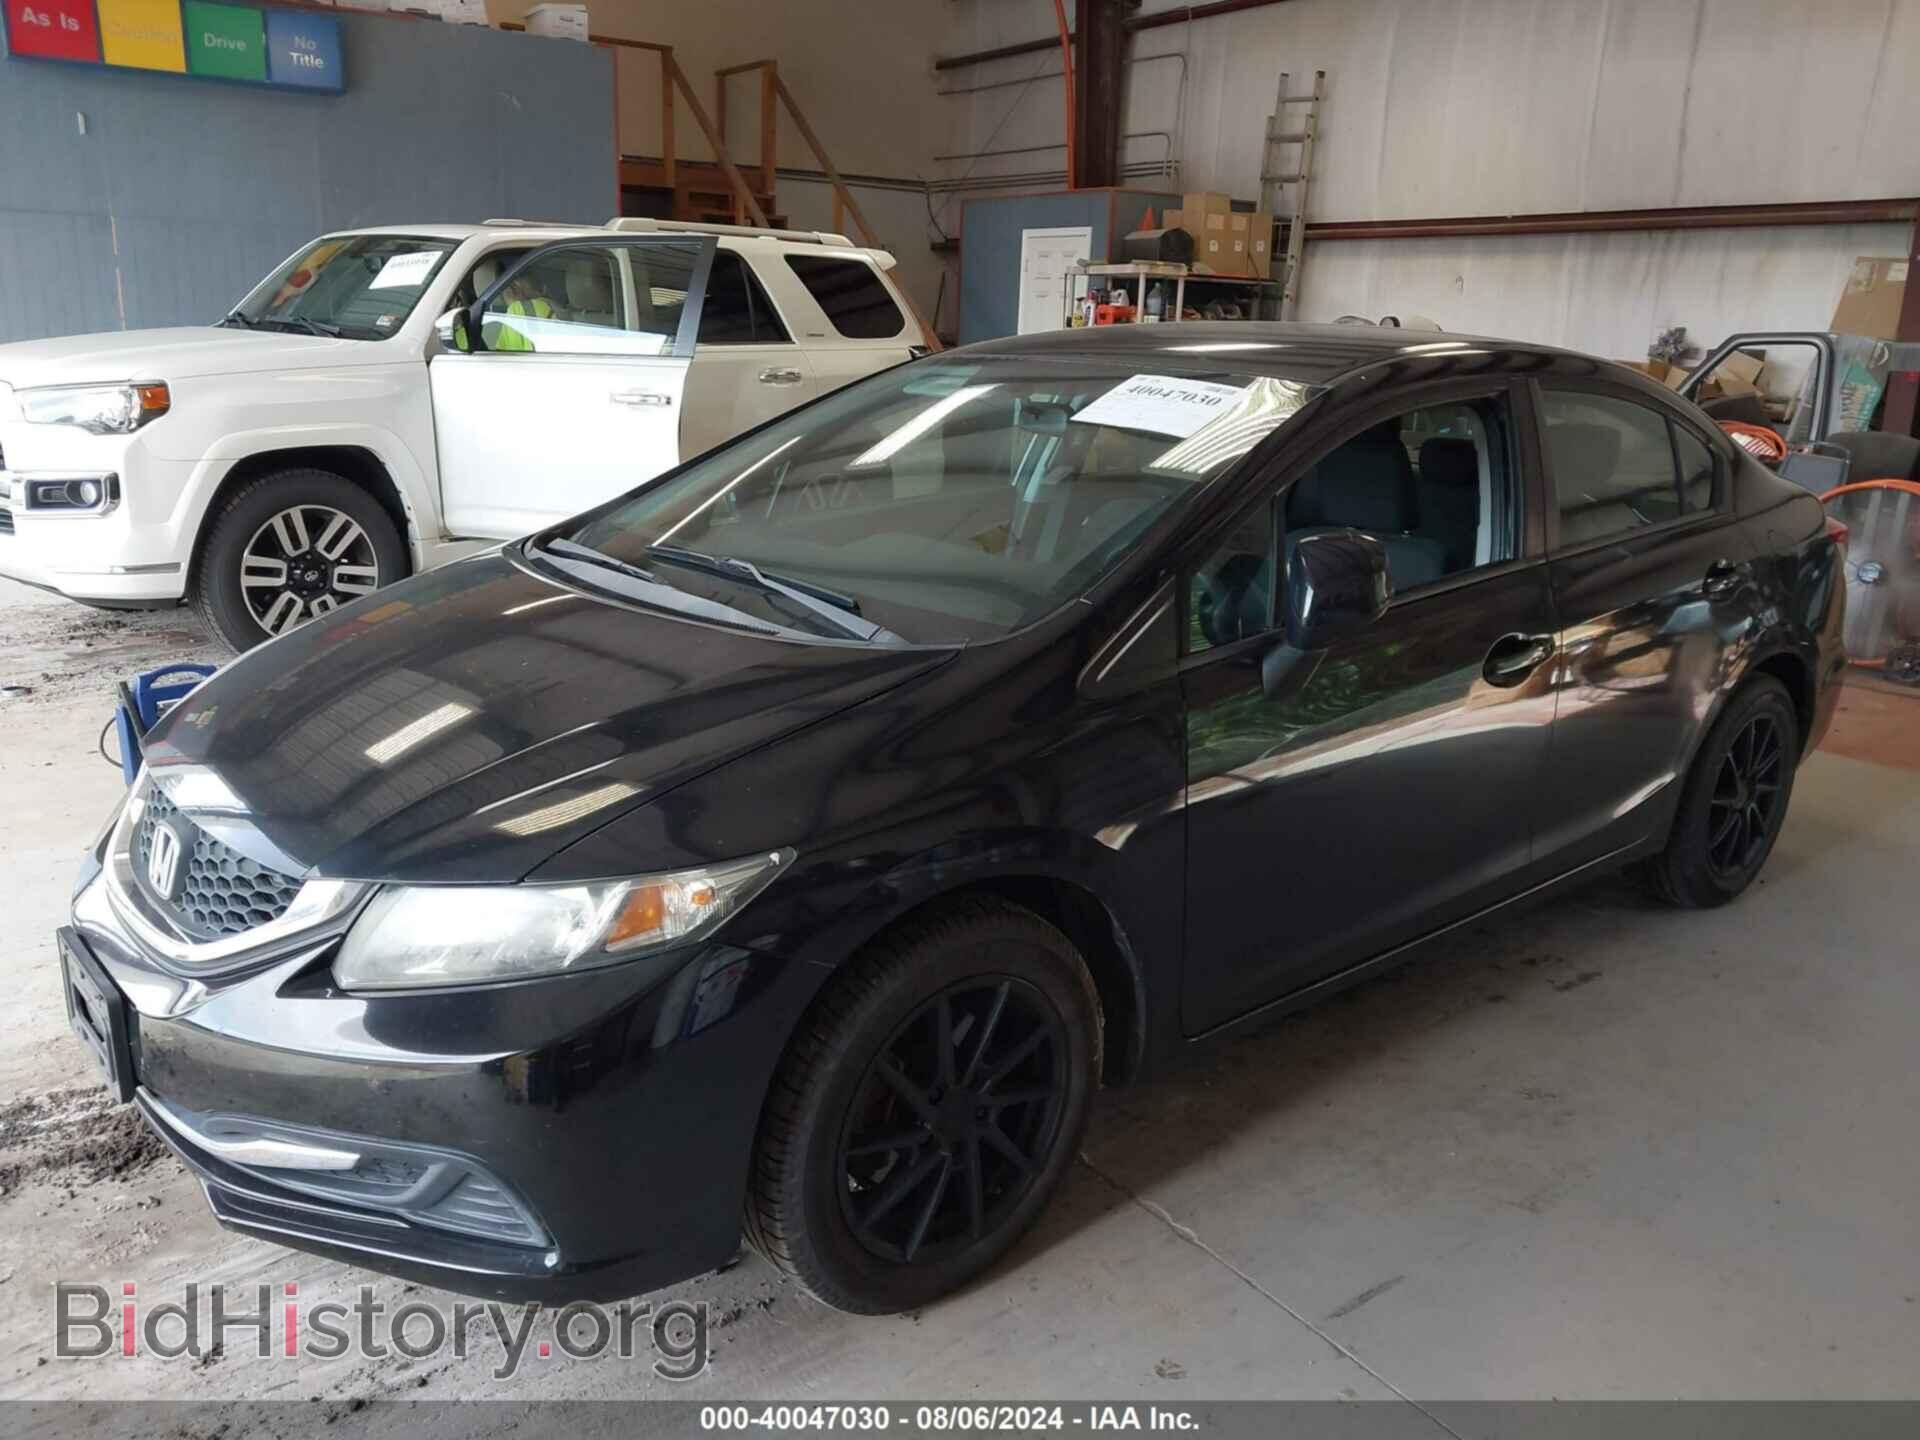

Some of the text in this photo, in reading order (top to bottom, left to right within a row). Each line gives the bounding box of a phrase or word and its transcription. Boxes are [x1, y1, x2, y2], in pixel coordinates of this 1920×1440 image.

[21, 7, 80, 31] As Is
[203, 32, 248, 51] Drive
[294, 35, 318, 51] No
[289, 52, 325, 69] Title
[1127, 385, 1222, 406] 40047030
